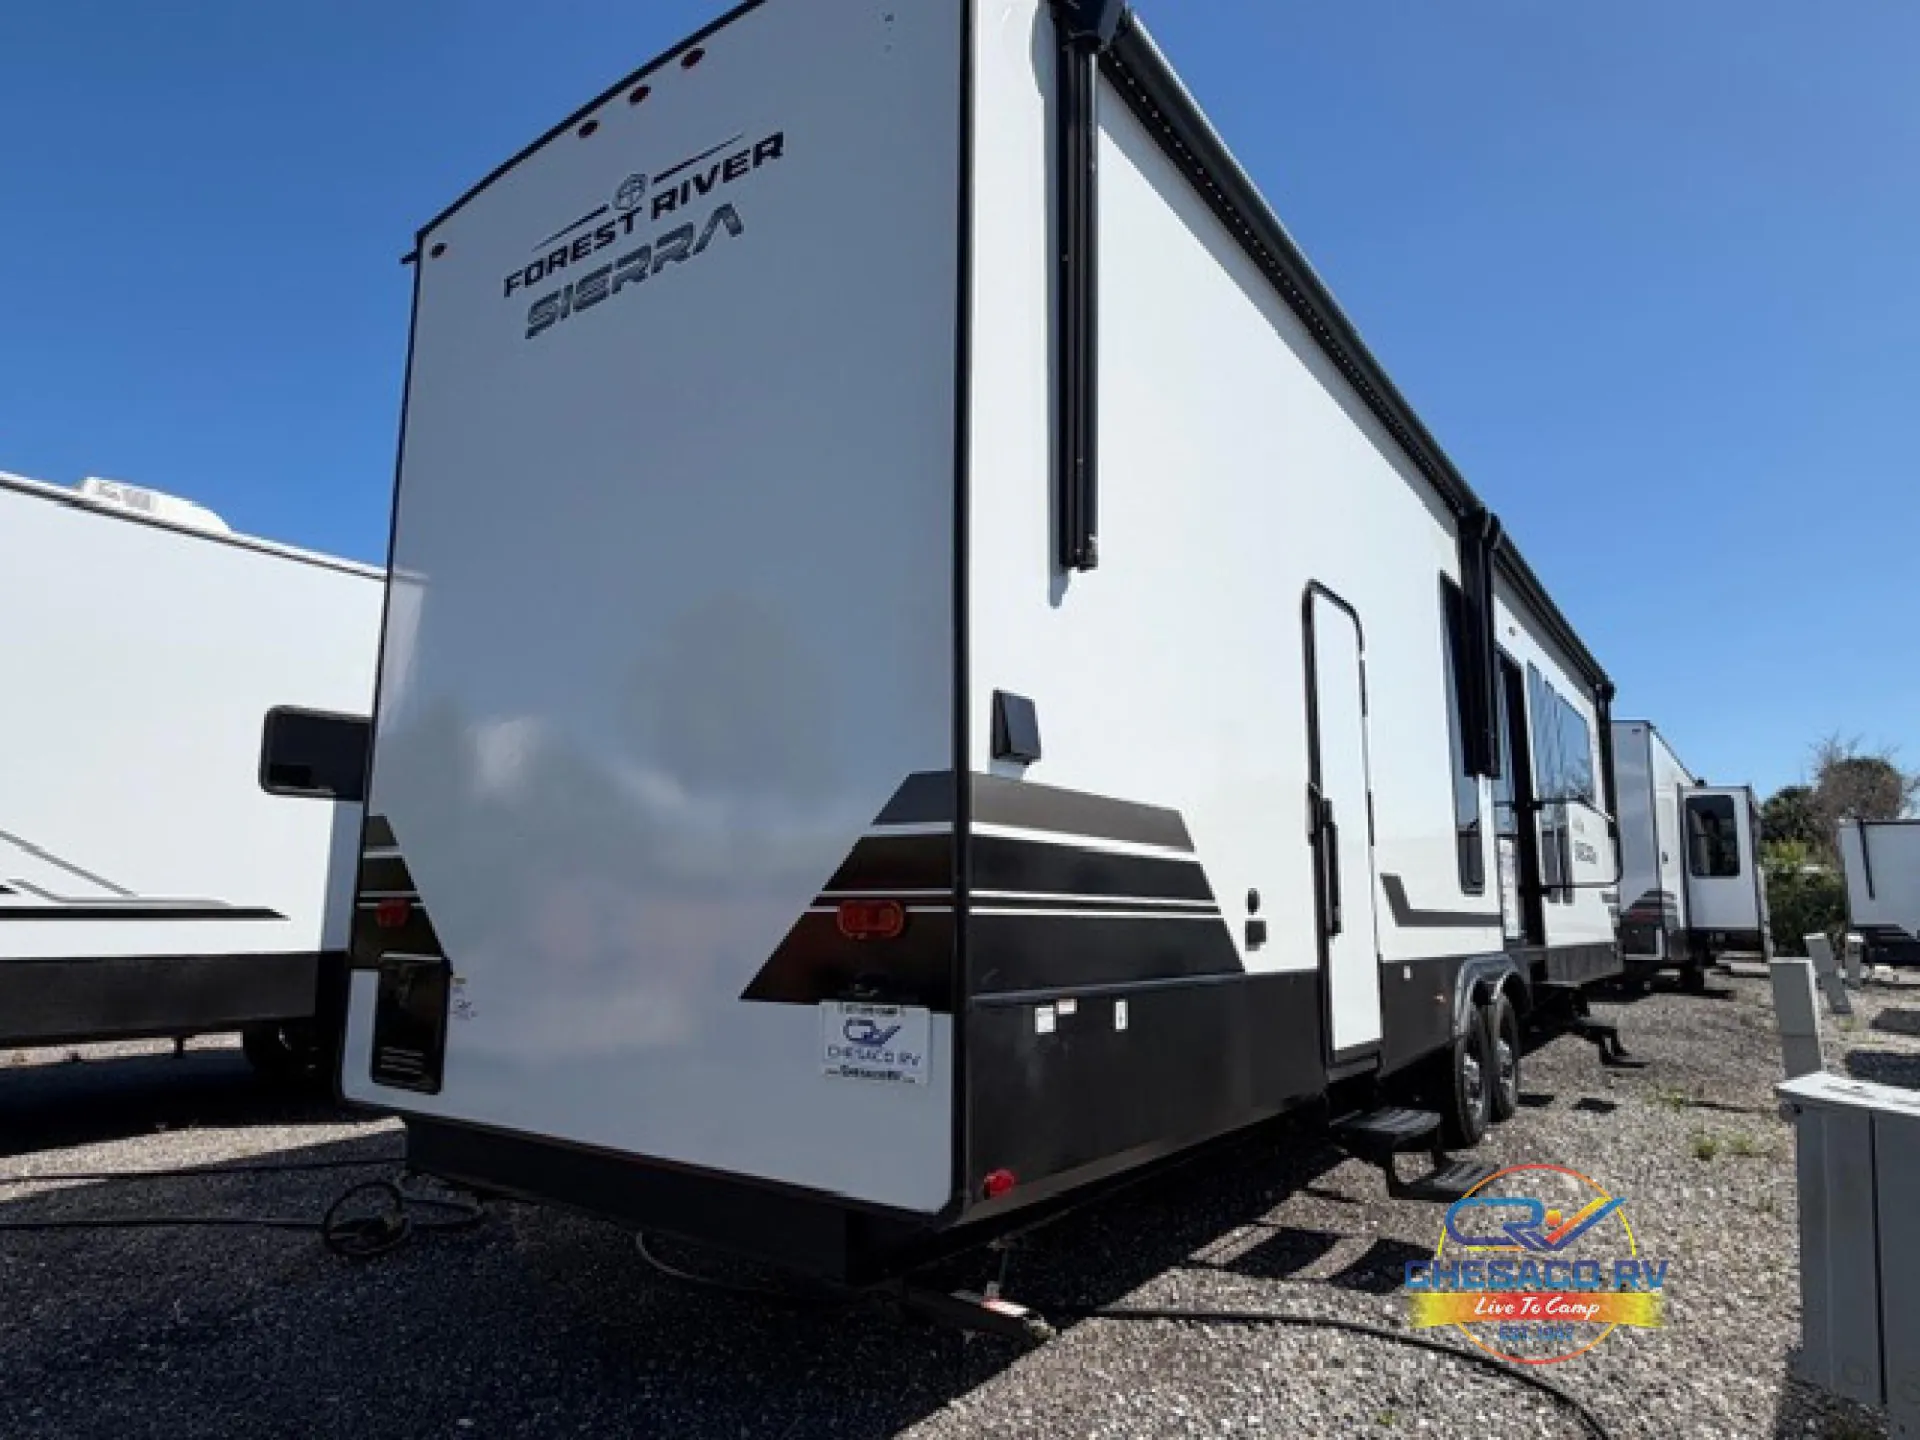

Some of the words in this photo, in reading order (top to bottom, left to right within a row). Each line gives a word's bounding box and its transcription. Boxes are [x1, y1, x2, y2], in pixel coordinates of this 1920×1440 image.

[504, 205, 643, 298] FOREST
[650, 131, 784, 220] RIVER
[525, 202, 744, 340] SIERRA
